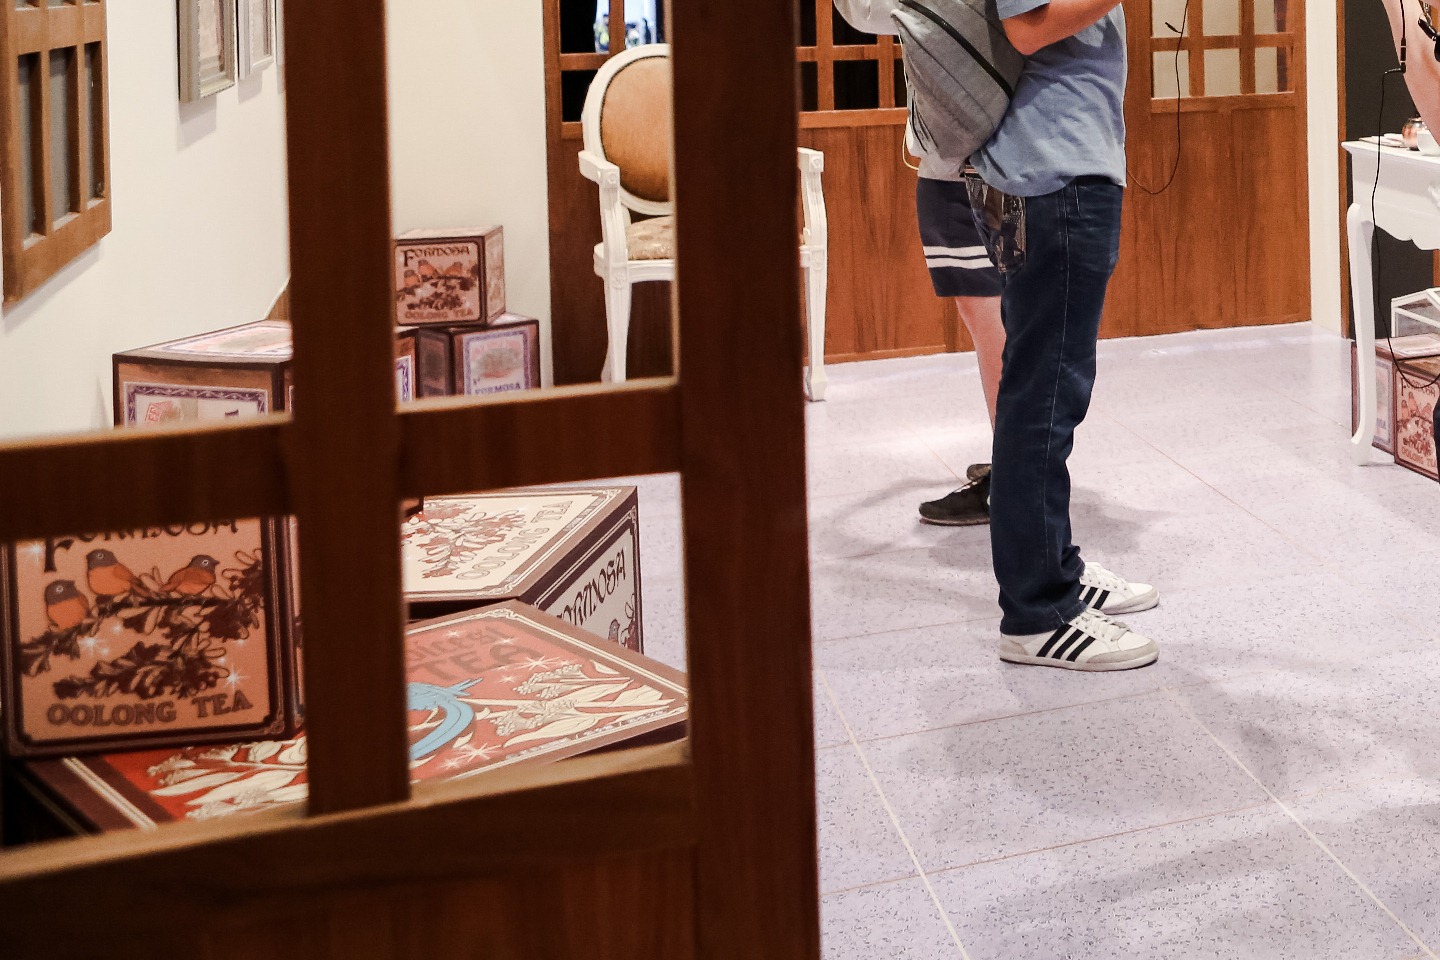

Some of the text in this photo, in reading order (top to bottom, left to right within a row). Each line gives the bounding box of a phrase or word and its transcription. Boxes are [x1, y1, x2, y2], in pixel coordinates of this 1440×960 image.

[403, 246, 470, 267] FORMOSA
[404, 307, 474, 320] OOLONG TEA
[456, 500, 574, 580] OOLONG TEA
[556, 547, 627, 628] ORMOSA
[408, 643, 546, 681] TEA
[46, 689, 254, 727] OOLONG TEA
